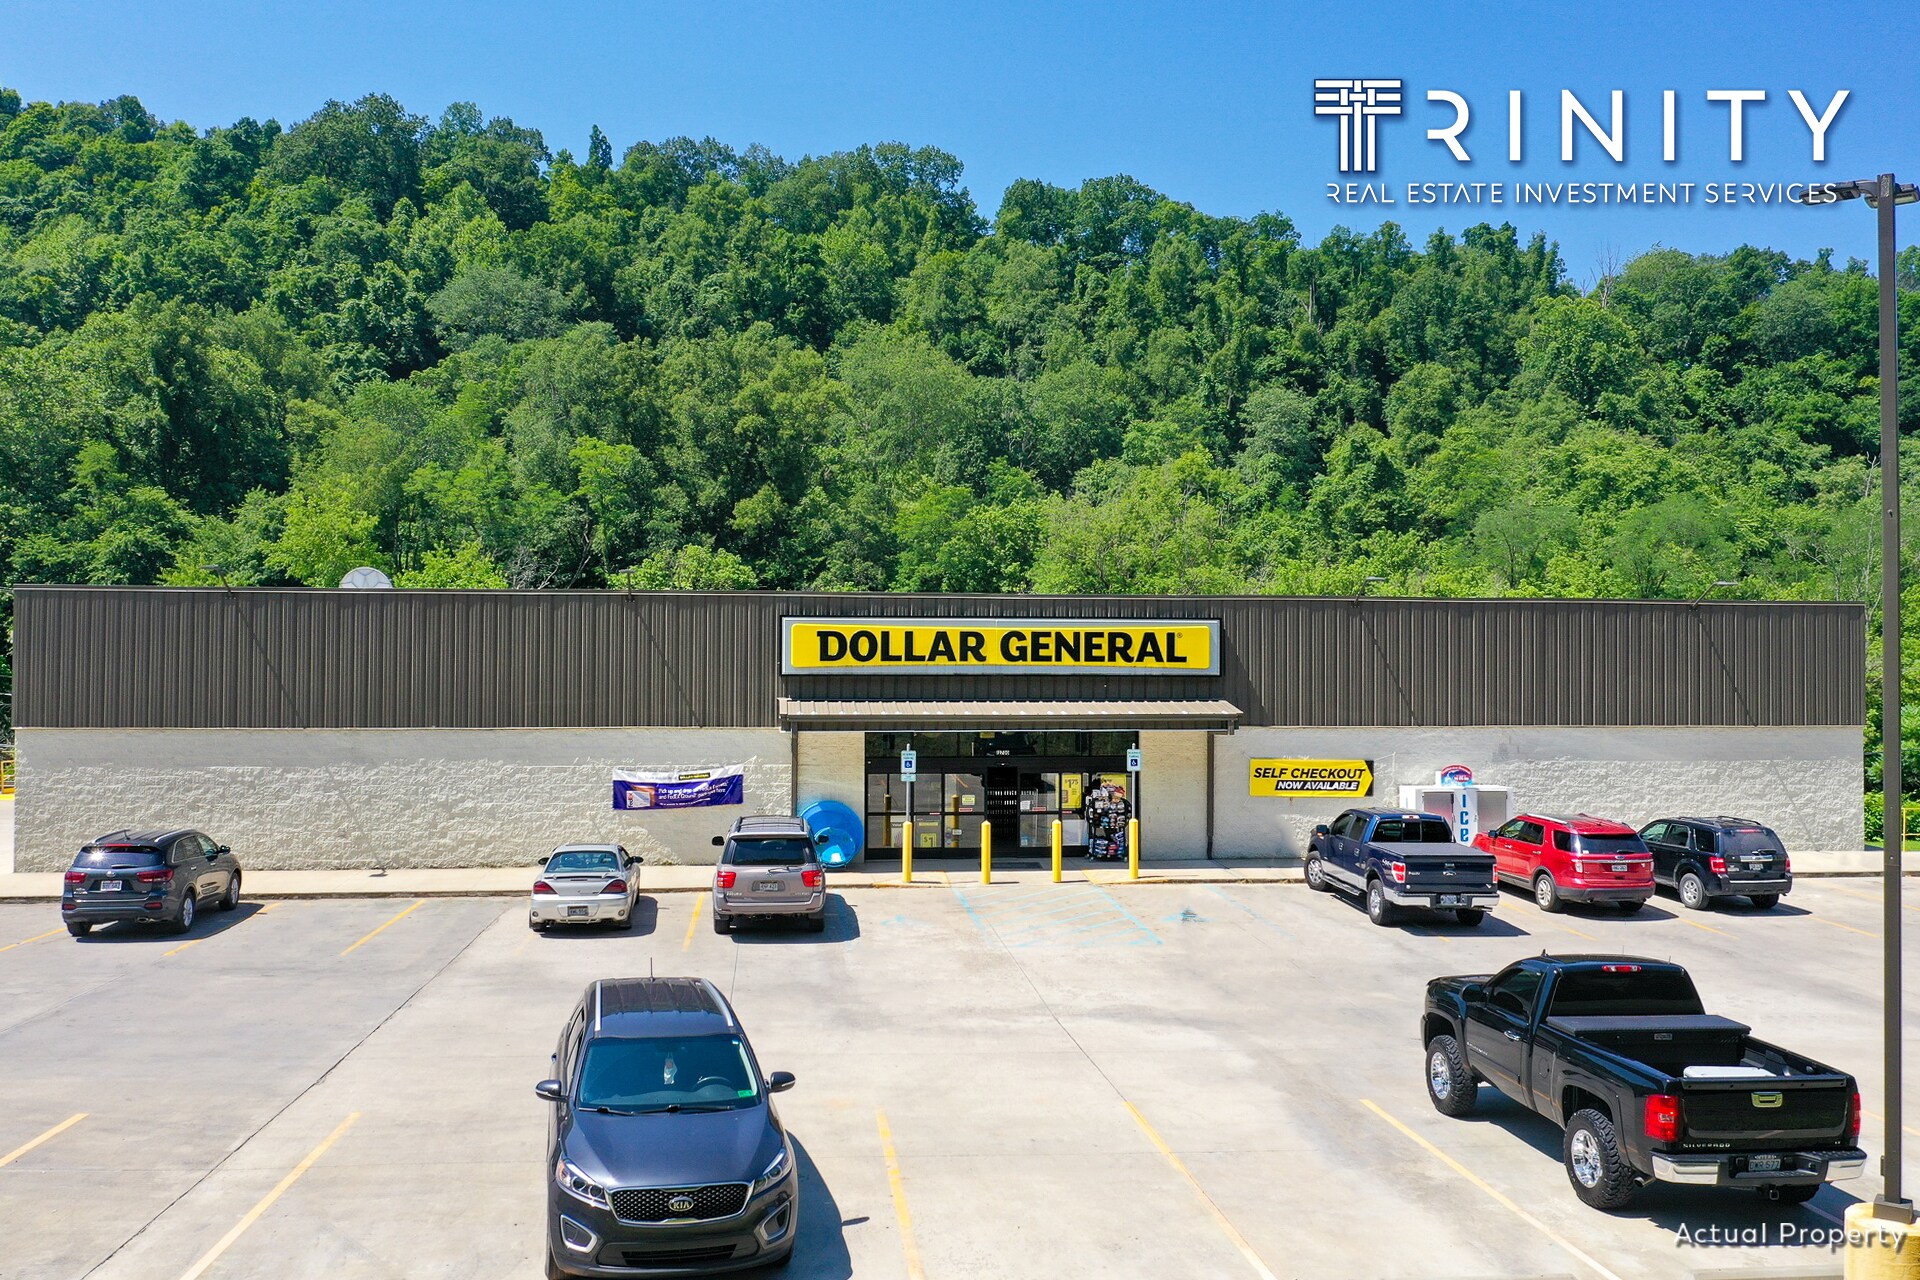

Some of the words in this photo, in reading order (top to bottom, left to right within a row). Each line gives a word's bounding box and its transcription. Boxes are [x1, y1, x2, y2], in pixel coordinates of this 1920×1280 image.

[816, 630, 987, 663] DOLLAR
[999, 630, 1187, 664] GENERAL
[1253, 767, 1288, 779] SELF
[1290, 768, 1366, 779] CHECKOUT
[1277, 781, 1304, 790] NOW
[1304, 781, 1358, 790] AVAILABLE
[673, 1200, 690, 1209] KIA
